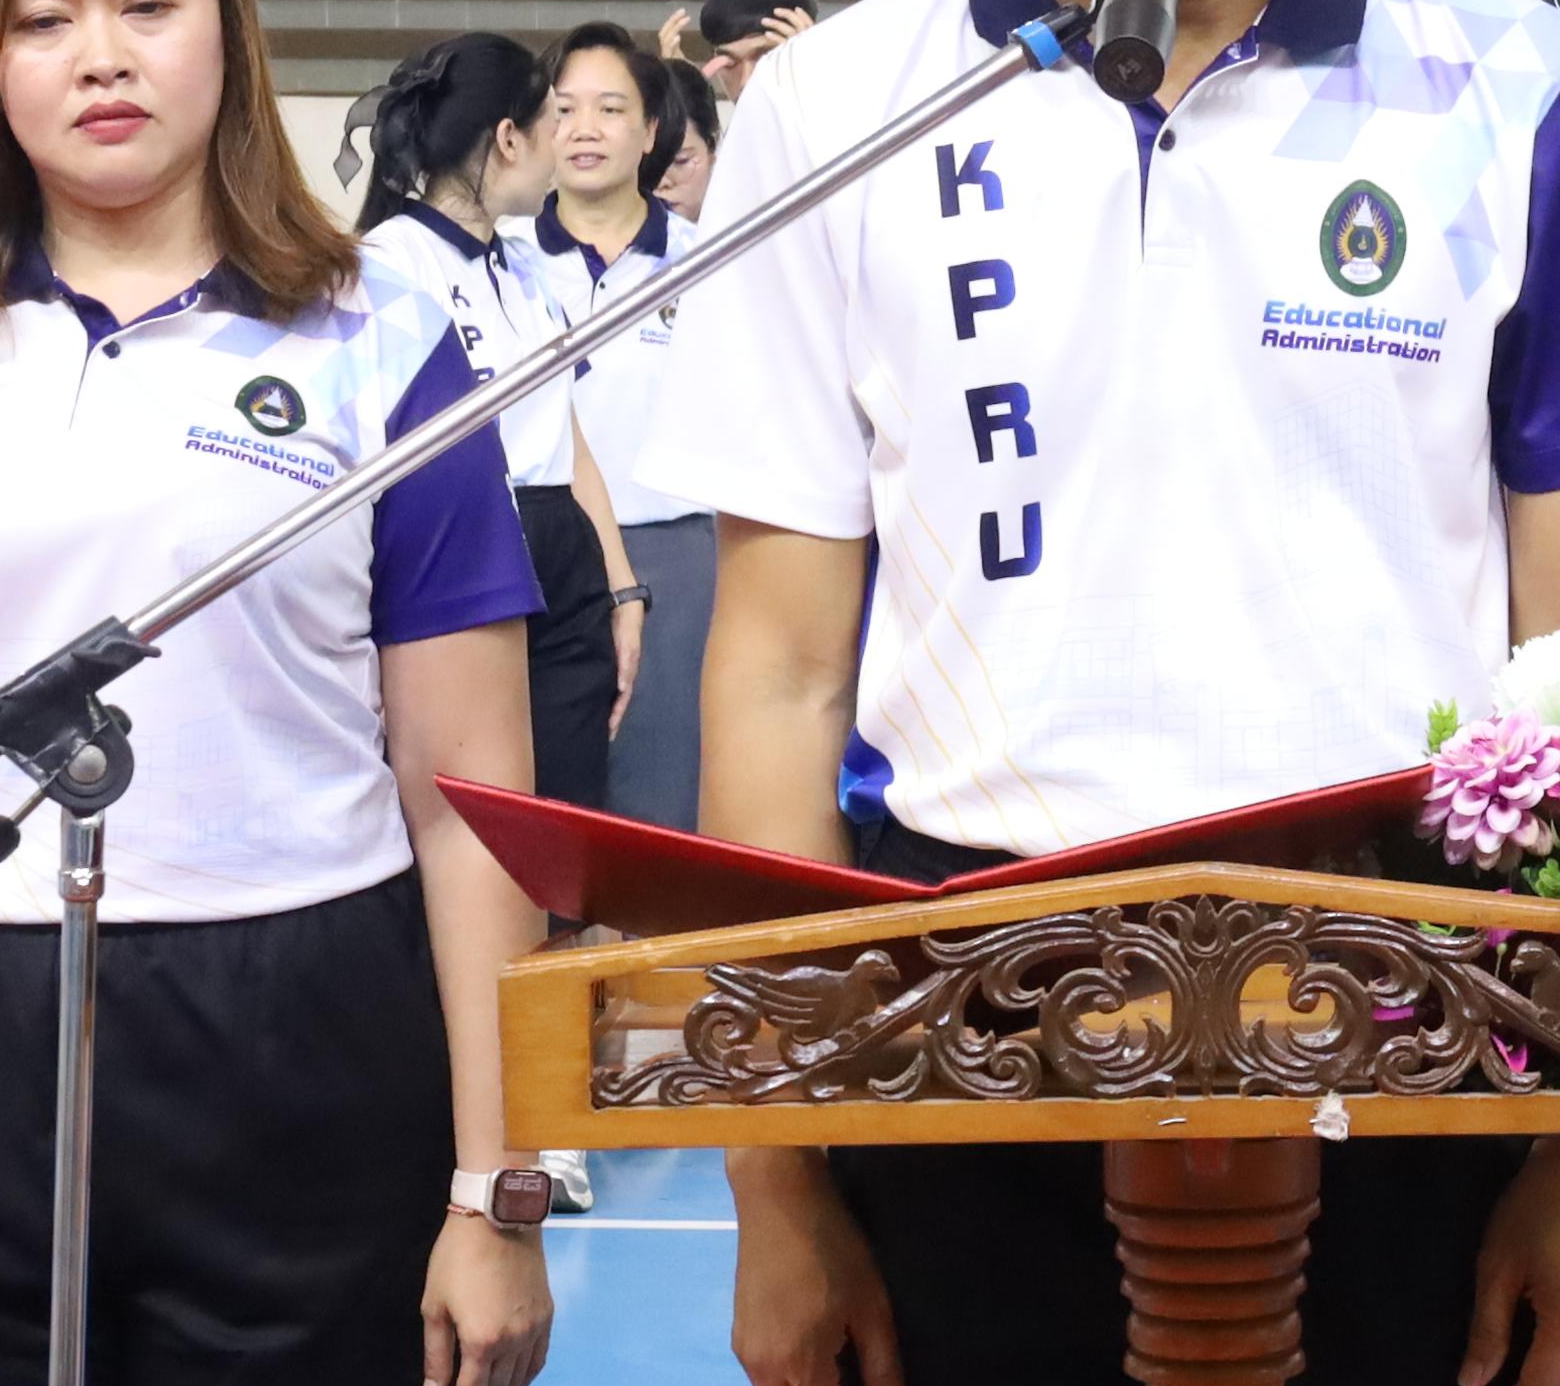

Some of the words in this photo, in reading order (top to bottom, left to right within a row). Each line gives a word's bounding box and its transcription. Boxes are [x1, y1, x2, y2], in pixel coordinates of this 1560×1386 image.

[1263, 300, 1447, 340] Educational
[934, 141, 1042, 581] KPRU
[1261, 329, 1441, 364] Administration
[187, 425, 335, 478] Educational
